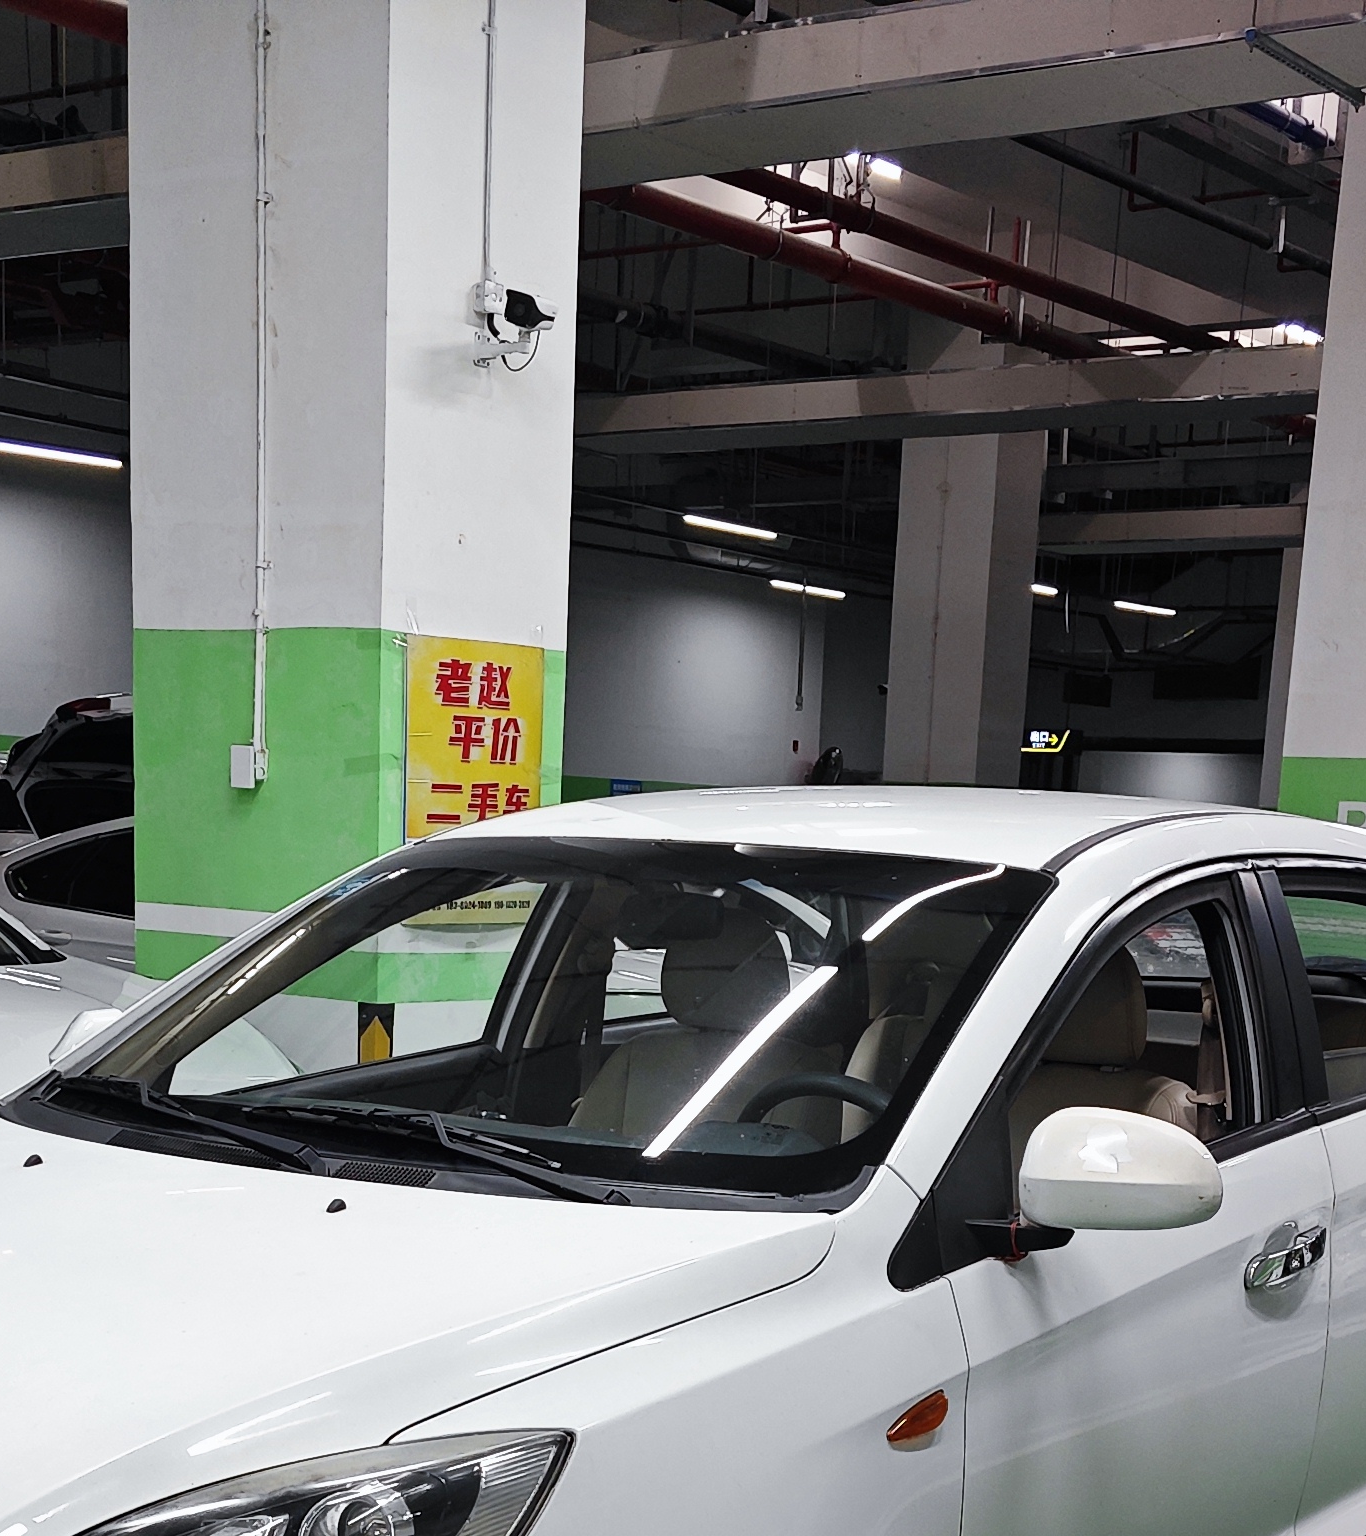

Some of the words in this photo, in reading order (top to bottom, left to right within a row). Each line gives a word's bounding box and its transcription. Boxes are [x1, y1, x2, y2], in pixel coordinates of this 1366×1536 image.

[435, 659, 512, 710] 老赵
[448, 715, 521, 765] 平价
[426, 783, 530, 824] 二手车
